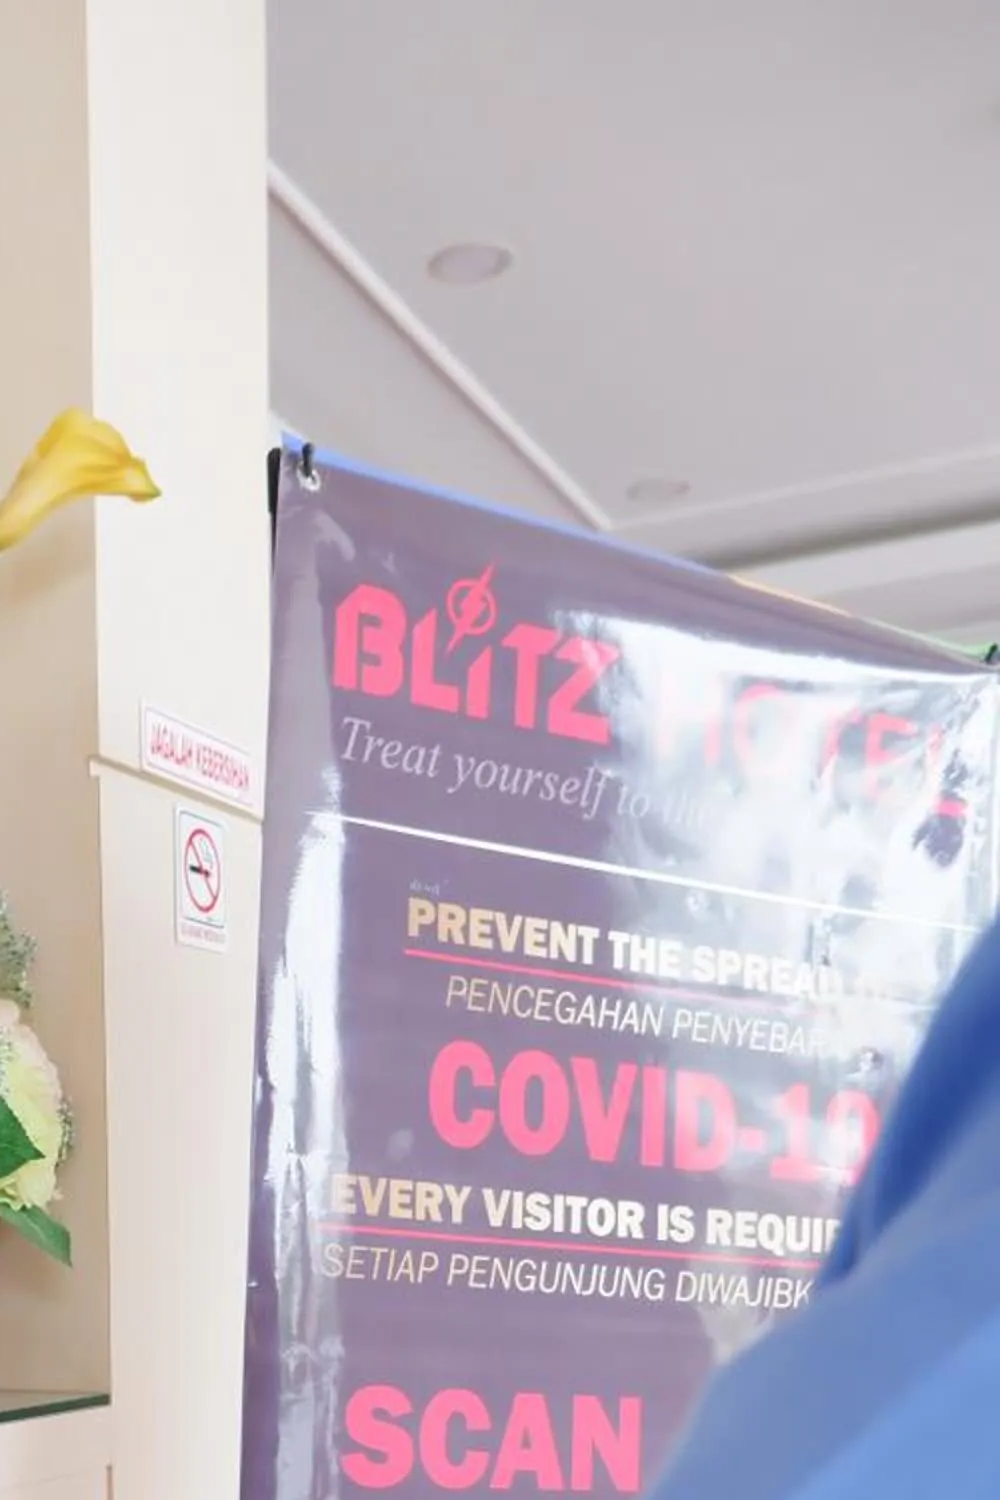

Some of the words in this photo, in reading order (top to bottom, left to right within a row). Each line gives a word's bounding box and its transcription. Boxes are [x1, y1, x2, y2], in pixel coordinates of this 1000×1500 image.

[340, 716, 442, 778] Treat
[446, 750, 612, 821] yourself
[407, 897, 601, 965] PREVENT
[608, 930, 683, 979] THE
[445, 975, 665, 1038] PENCEGAHAN
[331, 1172, 473, 1225] EVERY
[481, 1187, 646, 1240] VISITOR
[657, 1203, 696, 1244] IS
[322, 1242, 440, 1285] SETIAP
[447, 1252, 667, 1303] PENGUNJUNG
[341, 1385, 643, 1493] SCAN
